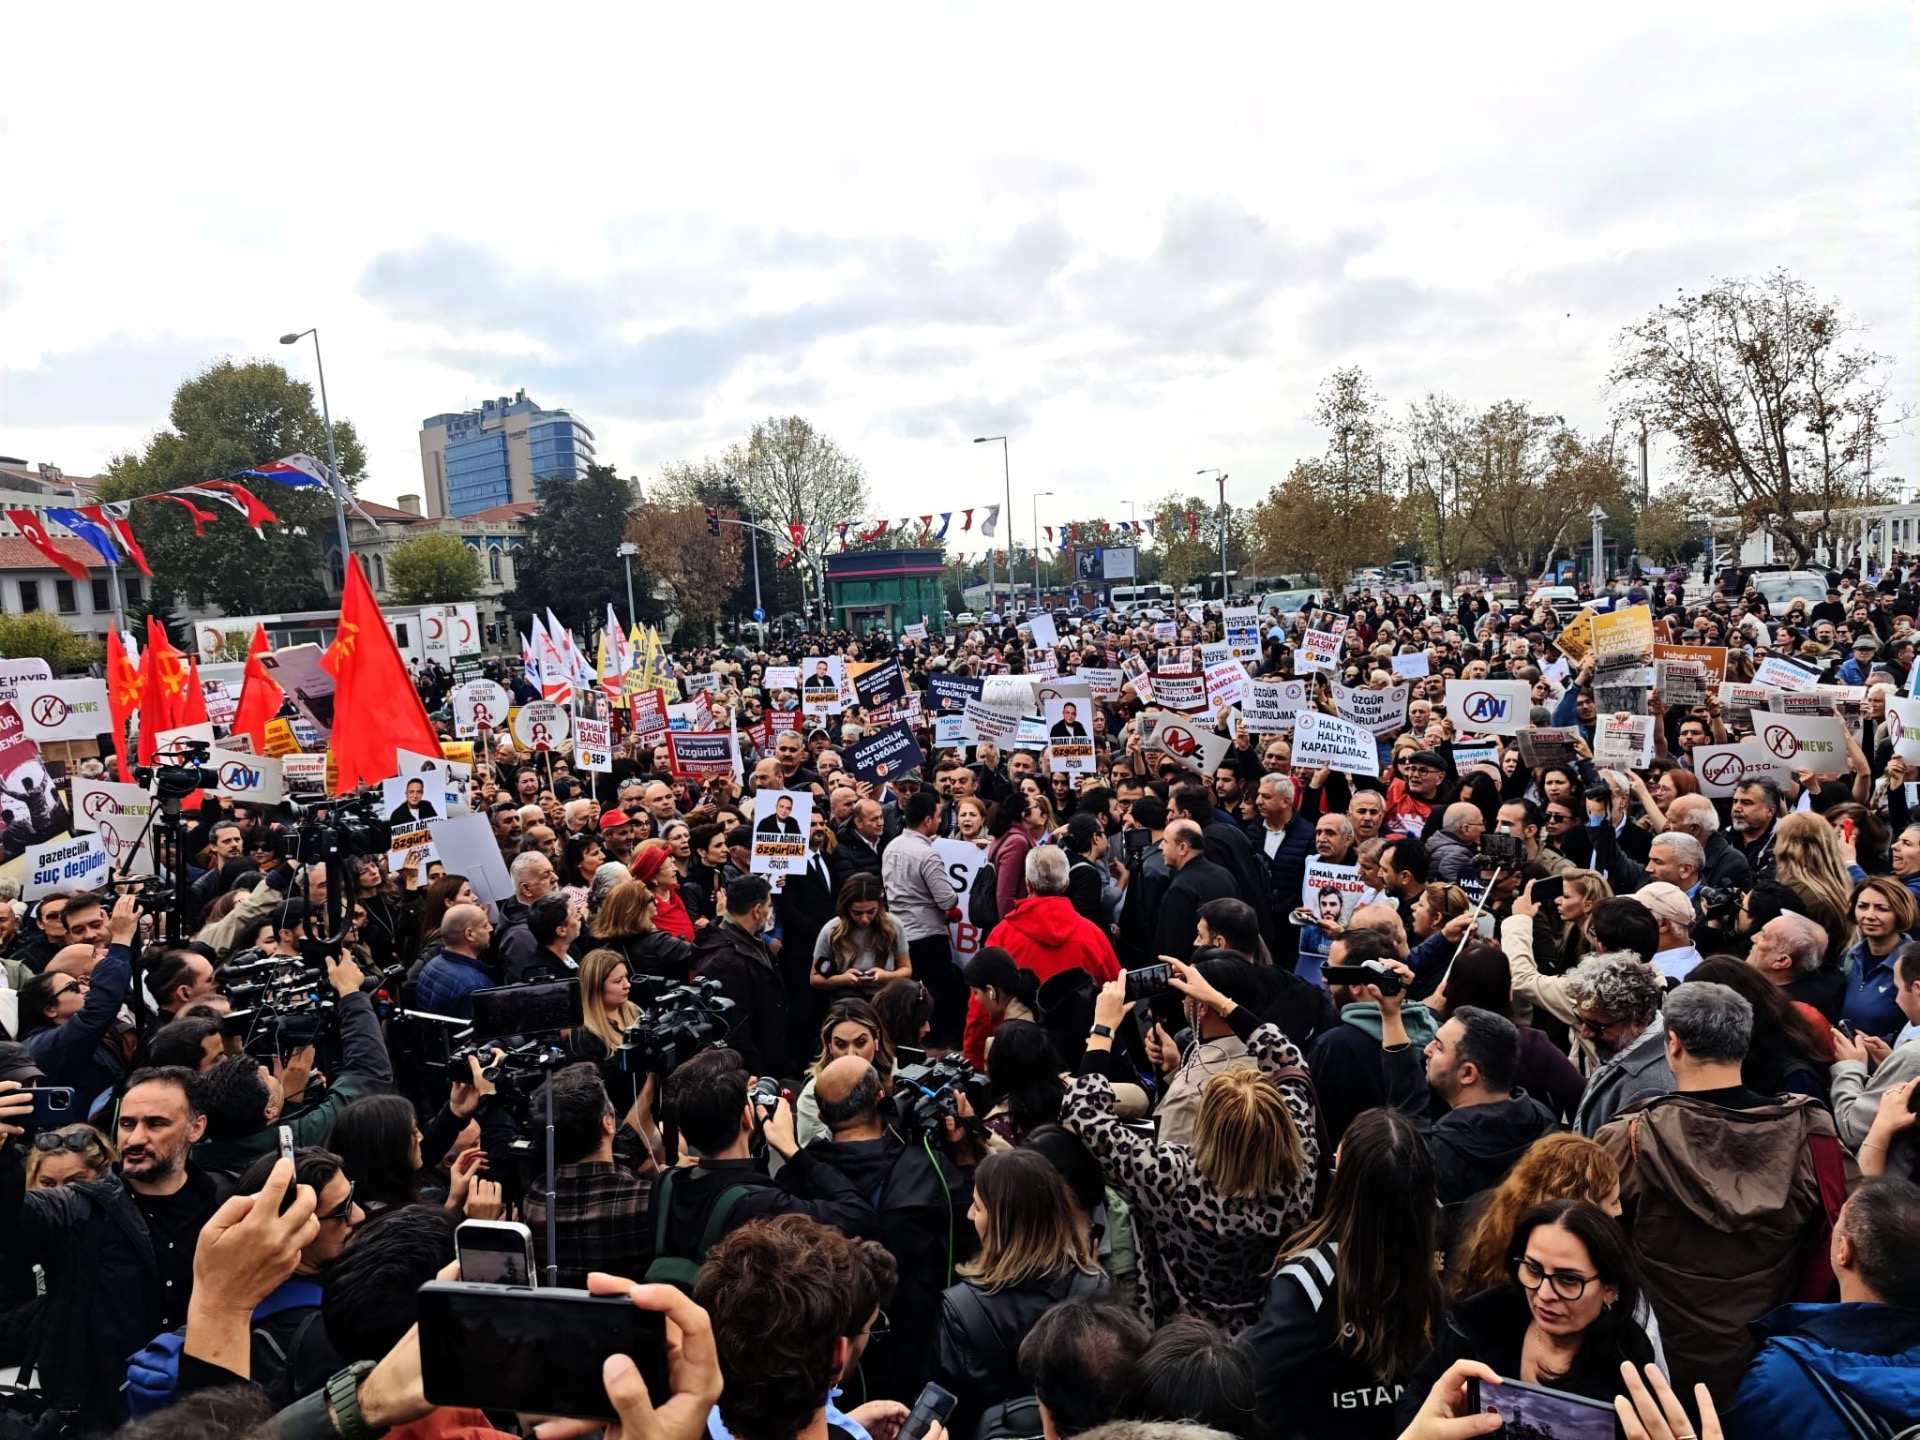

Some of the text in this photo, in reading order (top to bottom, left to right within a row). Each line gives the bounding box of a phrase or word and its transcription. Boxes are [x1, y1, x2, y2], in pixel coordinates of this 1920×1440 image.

[1226, 620, 1257, 628] TUTSAK
[1306, 631, 1342, 643] MUHALİF
[1307, 639, 1336, 650] BASIN
[1204, 655, 1228, 663] TUTSA
[1314, 654, 1331, 663] SEP
[1663, 651, 1712, 661] Haber alma
[1666, 666, 1699, 675] evrensel
[931, 679, 980, 693] GAZETECİLERE
[1206, 674, 1243, 693] ANACAĞIZ
[1253, 685, 1279, 698] ÖZGÜR
[1733, 689, 1766, 698] evrensel
[805, 694, 839, 702] özgürlük!
[1351, 692, 1384, 705] ÖZGÜR
[1784, 696, 1820, 706] evrensel
[58, 701, 99, 716] JNNEWS
[1256, 700, 1279, 709] BASIN
[1354, 705, 1382, 714] BASIN
[1475, 698, 1507, 718] AW
[1191, 716, 1215, 724] TUKLU
[1242, 709, 1297, 720] USTURULAMA
[577, 721, 608, 732] MUHALİF
[1319, 719, 1356, 736] HALK TV
[0, 733, 26, 752] EMEZ
[580, 732, 606, 745] BASIN
[644, 733, 660, 743] EHP
[1317, 731, 1357, 746] HALKTIR
[1530, 732, 1565, 741] evrensel
[677, 744, 725, 758] Özgürlük
[855, 730, 905, 760] GAZETECİLİK
[1052, 745, 1092, 757] özgürlük!
[1301, 741, 1370, 760] KAPATILAMAZ.
[1788, 740, 1834, 752] JNNEWS
[592, 753, 606, 765] SEP
[856, 738, 911, 771] SUÇ DEĞİLDİR
[1455, 750, 1492, 760] aevindeki
[1457, 758, 1490, 767] etecil
[229, 768, 260, 788] AW
[391, 824, 414, 838] MURAT
[392, 829, 433, 850] özgürl
[755, 833, 779, 843] MURAT
[39, 841, 91, 868] gazetecilik
[756, 844, 806, 856] özgürlük!
[34, 850, 106, 885] suç değildir!
[1309, 867, 1335, 880] İSMAİL
[949, 863, 969, 893] S
[1460, 878, 1484, 889] HAB
[1308, 878, 1365, 893] ÖZGÜRLÜK
